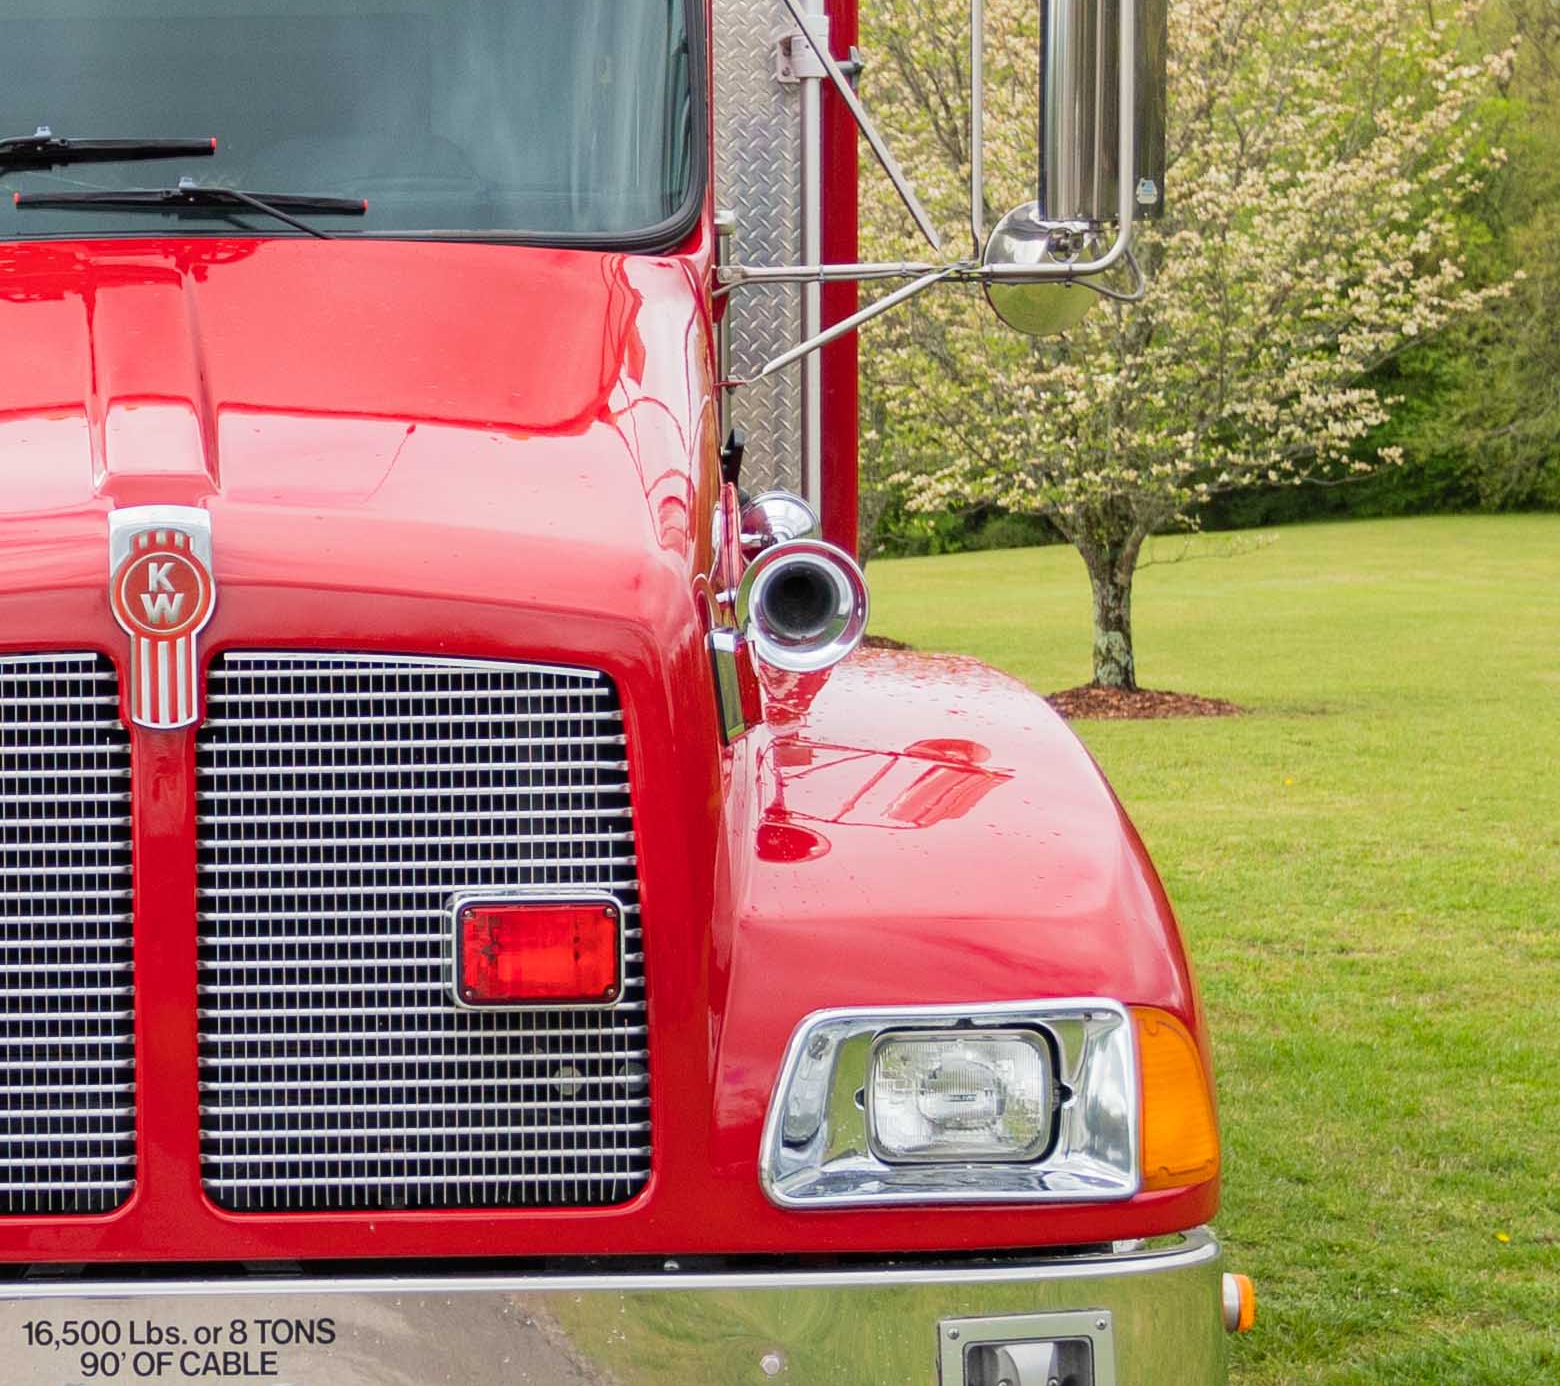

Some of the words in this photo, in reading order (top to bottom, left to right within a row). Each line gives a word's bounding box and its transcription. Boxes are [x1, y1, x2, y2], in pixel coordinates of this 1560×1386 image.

[22, 1320, 121, 1350] 16,500
[130, 1320, 187, 1345] Lbs.
[194, 1325, 223, 1345] or
[229, 1319, 248, 1345] 8
[254, 1318, 336, 1345] TONS
[80, 1351, 126, 1377] 90'
[133, 1351, 174, 1376] OF
[180, 1351, 278, 1376] CABLE
